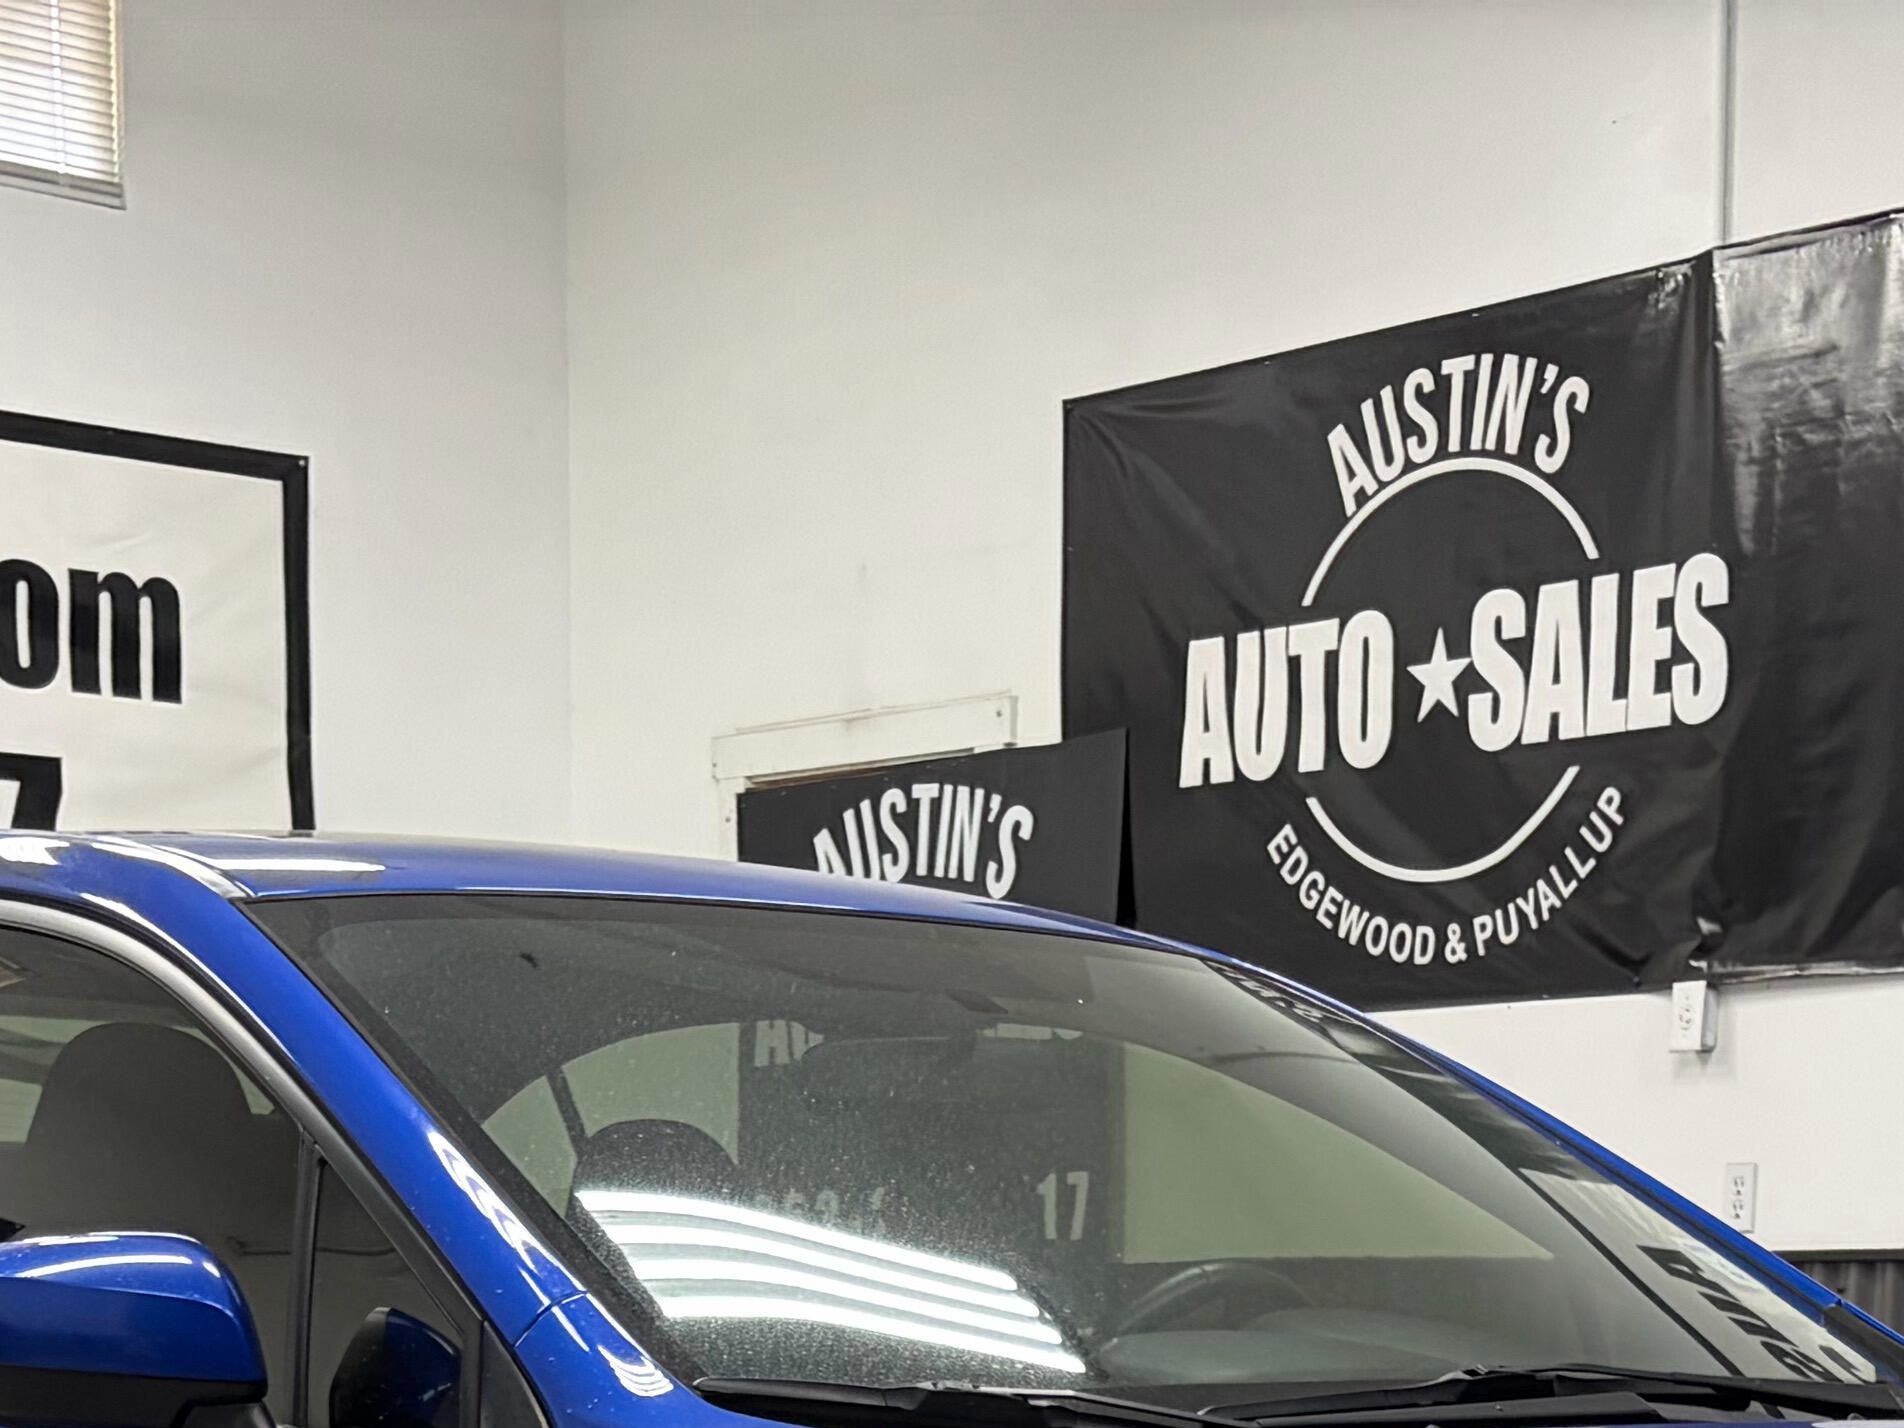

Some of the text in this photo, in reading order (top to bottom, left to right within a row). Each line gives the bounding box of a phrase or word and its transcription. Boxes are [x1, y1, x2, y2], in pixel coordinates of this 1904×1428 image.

[1326, 352, 1591, 518] AUSTIN'S
[1178, 552, 1730, 788] AUTO SALES
[1266, 785, 1625, 965] EDGEWOOD & PUYALLUP
